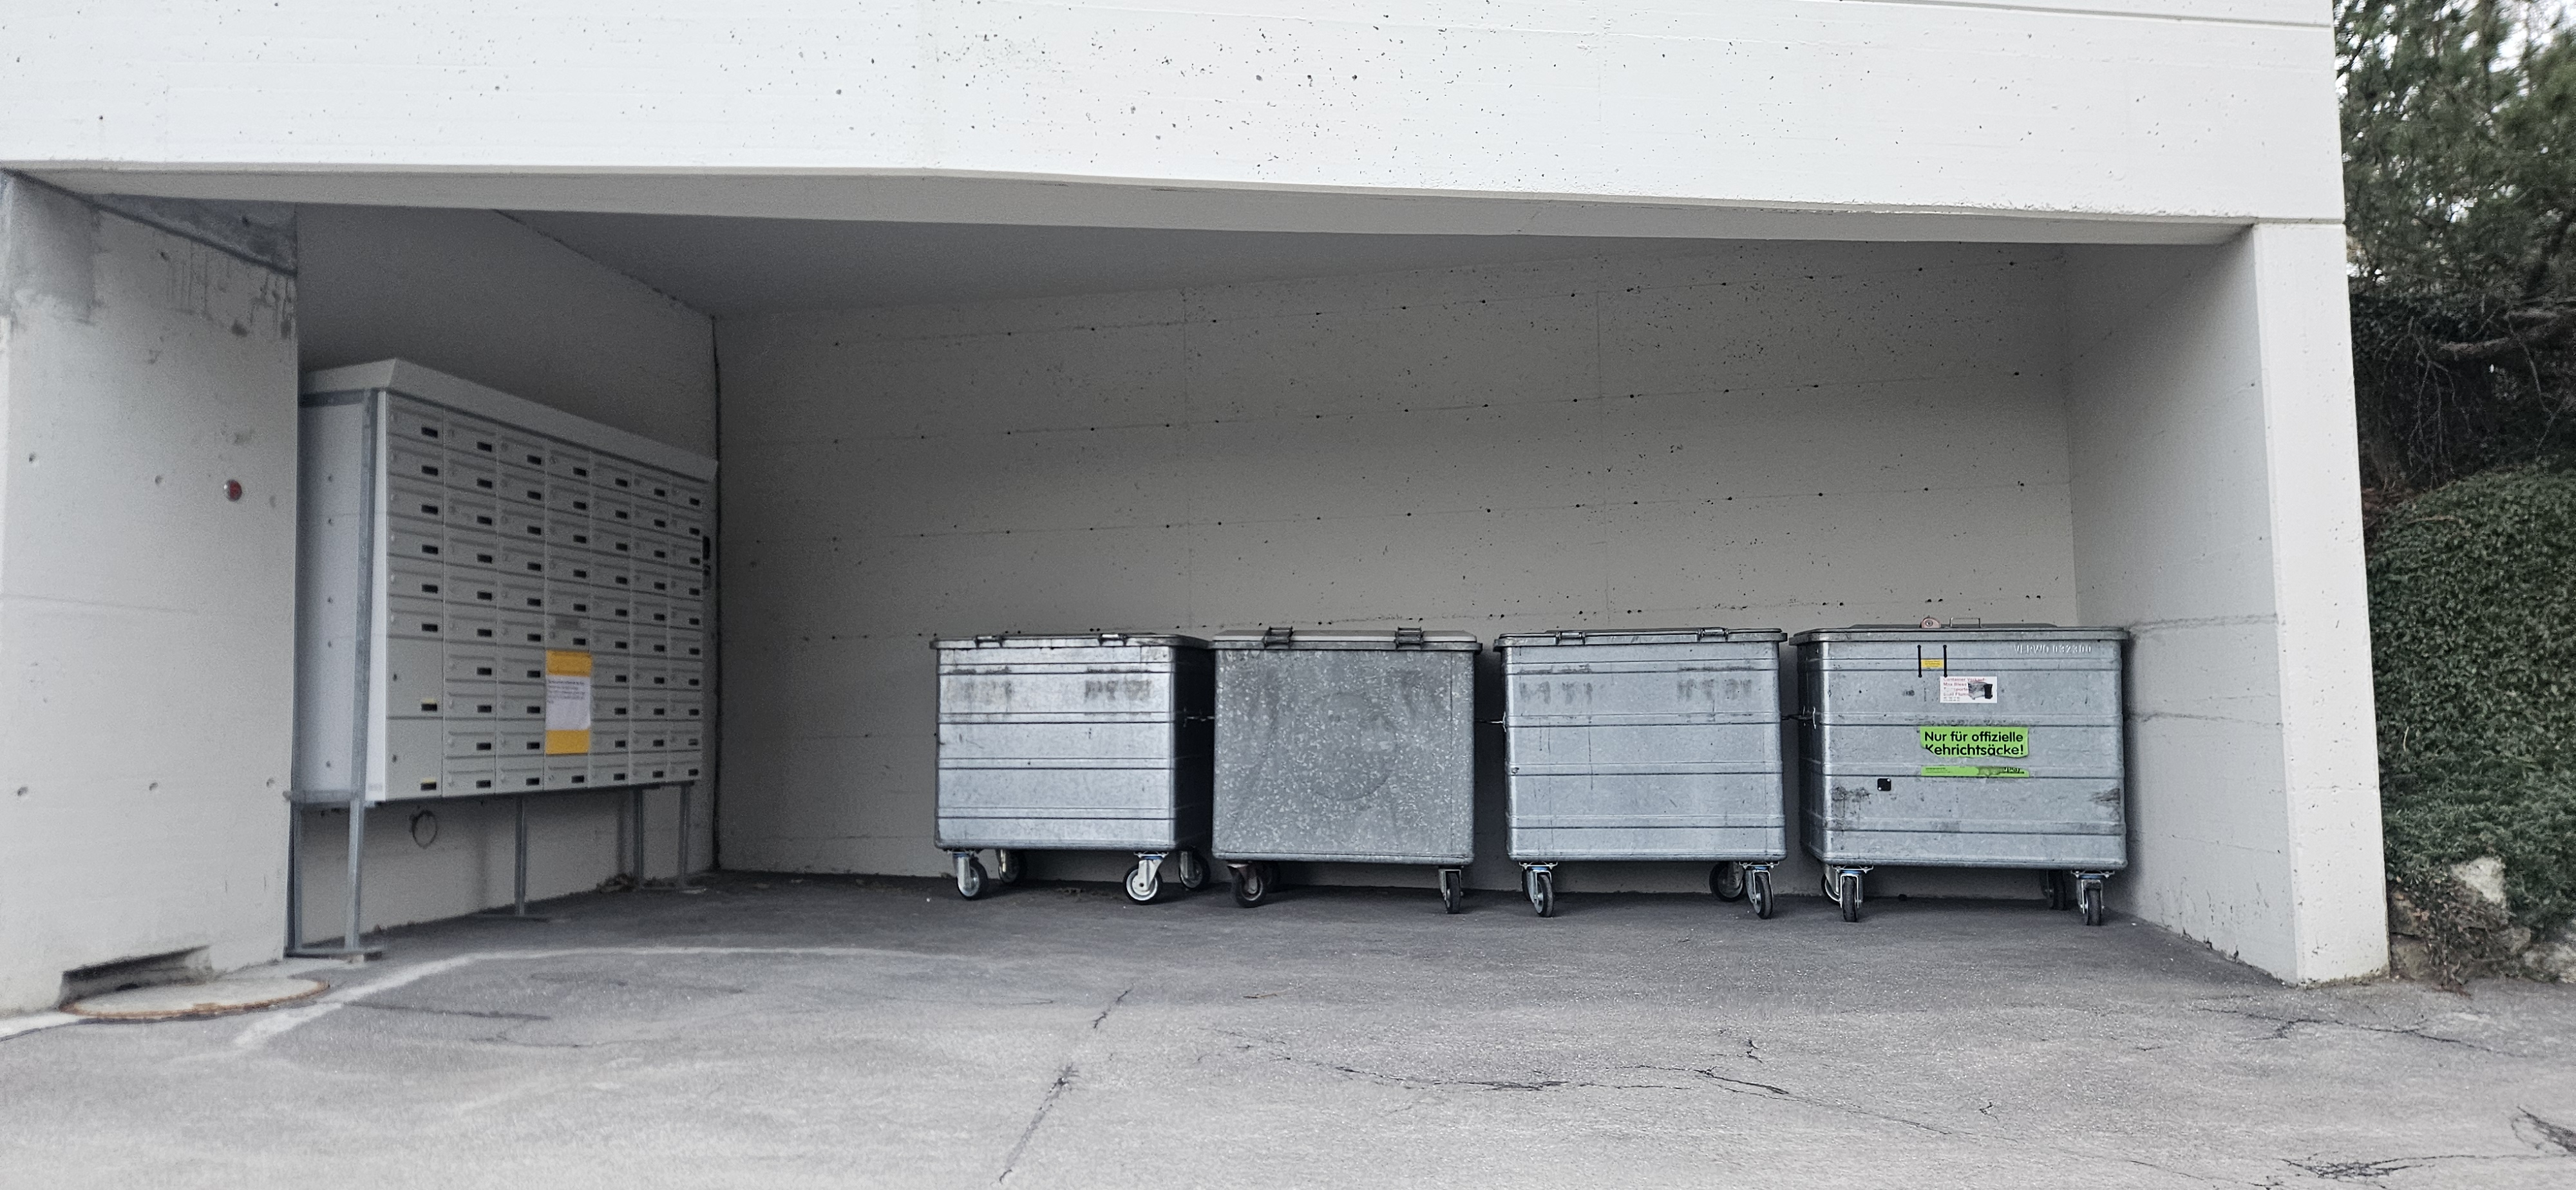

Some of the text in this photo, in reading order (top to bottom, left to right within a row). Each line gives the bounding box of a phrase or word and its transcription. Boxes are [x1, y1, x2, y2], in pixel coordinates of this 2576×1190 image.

[1924, 731, 2023, 742] Nur für offizielle
[1925, 744, 2023, 756] Kehrichtsäcke!
